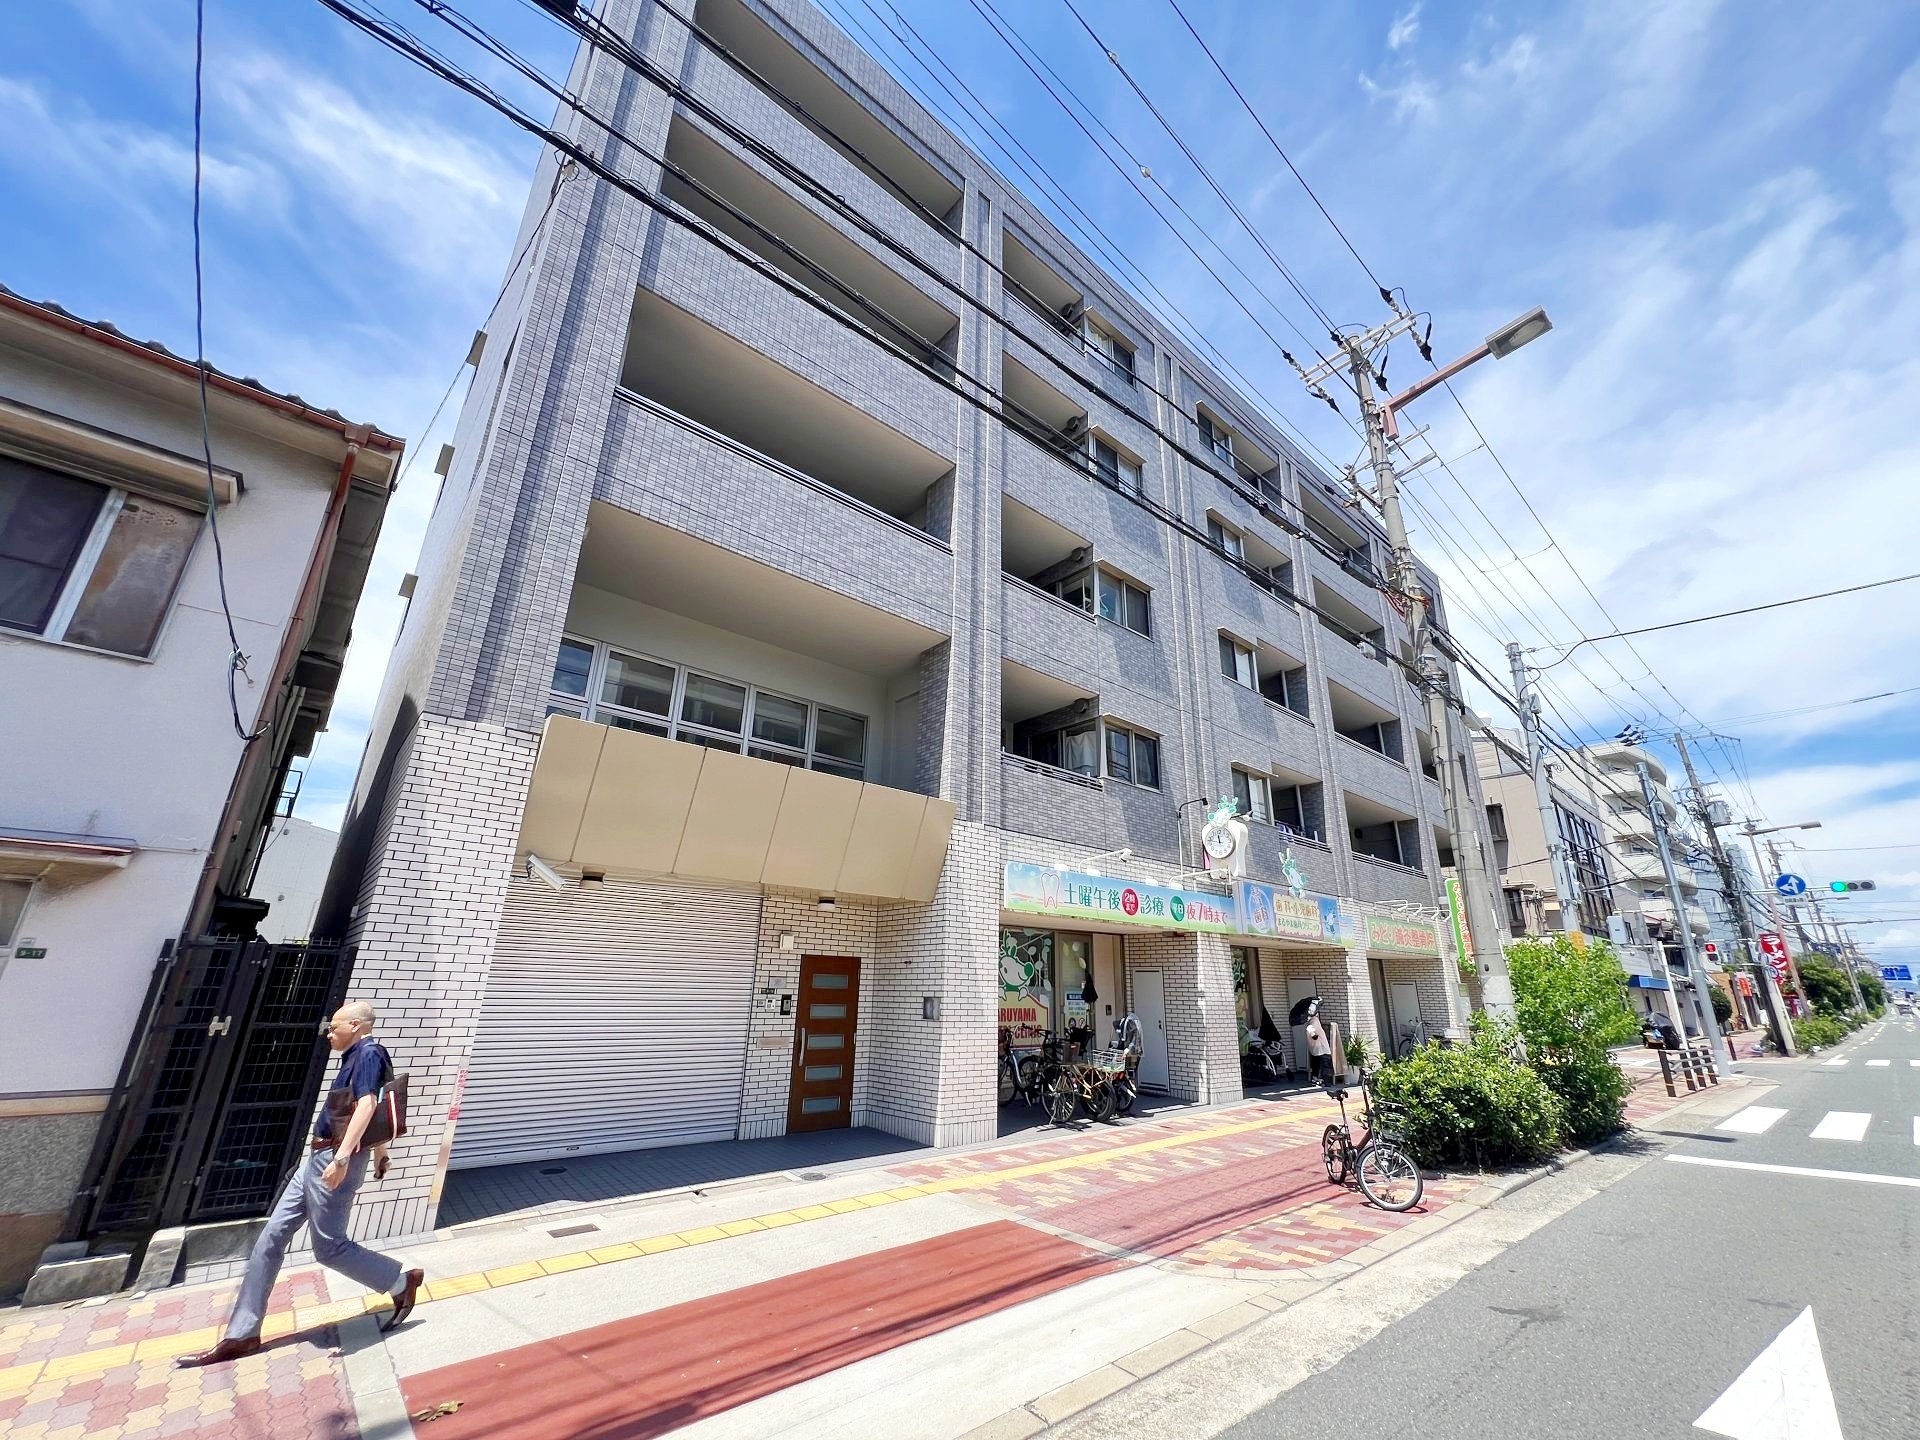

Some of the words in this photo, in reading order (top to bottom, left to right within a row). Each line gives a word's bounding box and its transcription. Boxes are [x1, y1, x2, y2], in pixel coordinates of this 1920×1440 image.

[1064, 883, 1120, 911] 土曜午後
[1140, 893, 1165, 917] 診療
[998, 1008, 1037, 1021] RUYAMA
